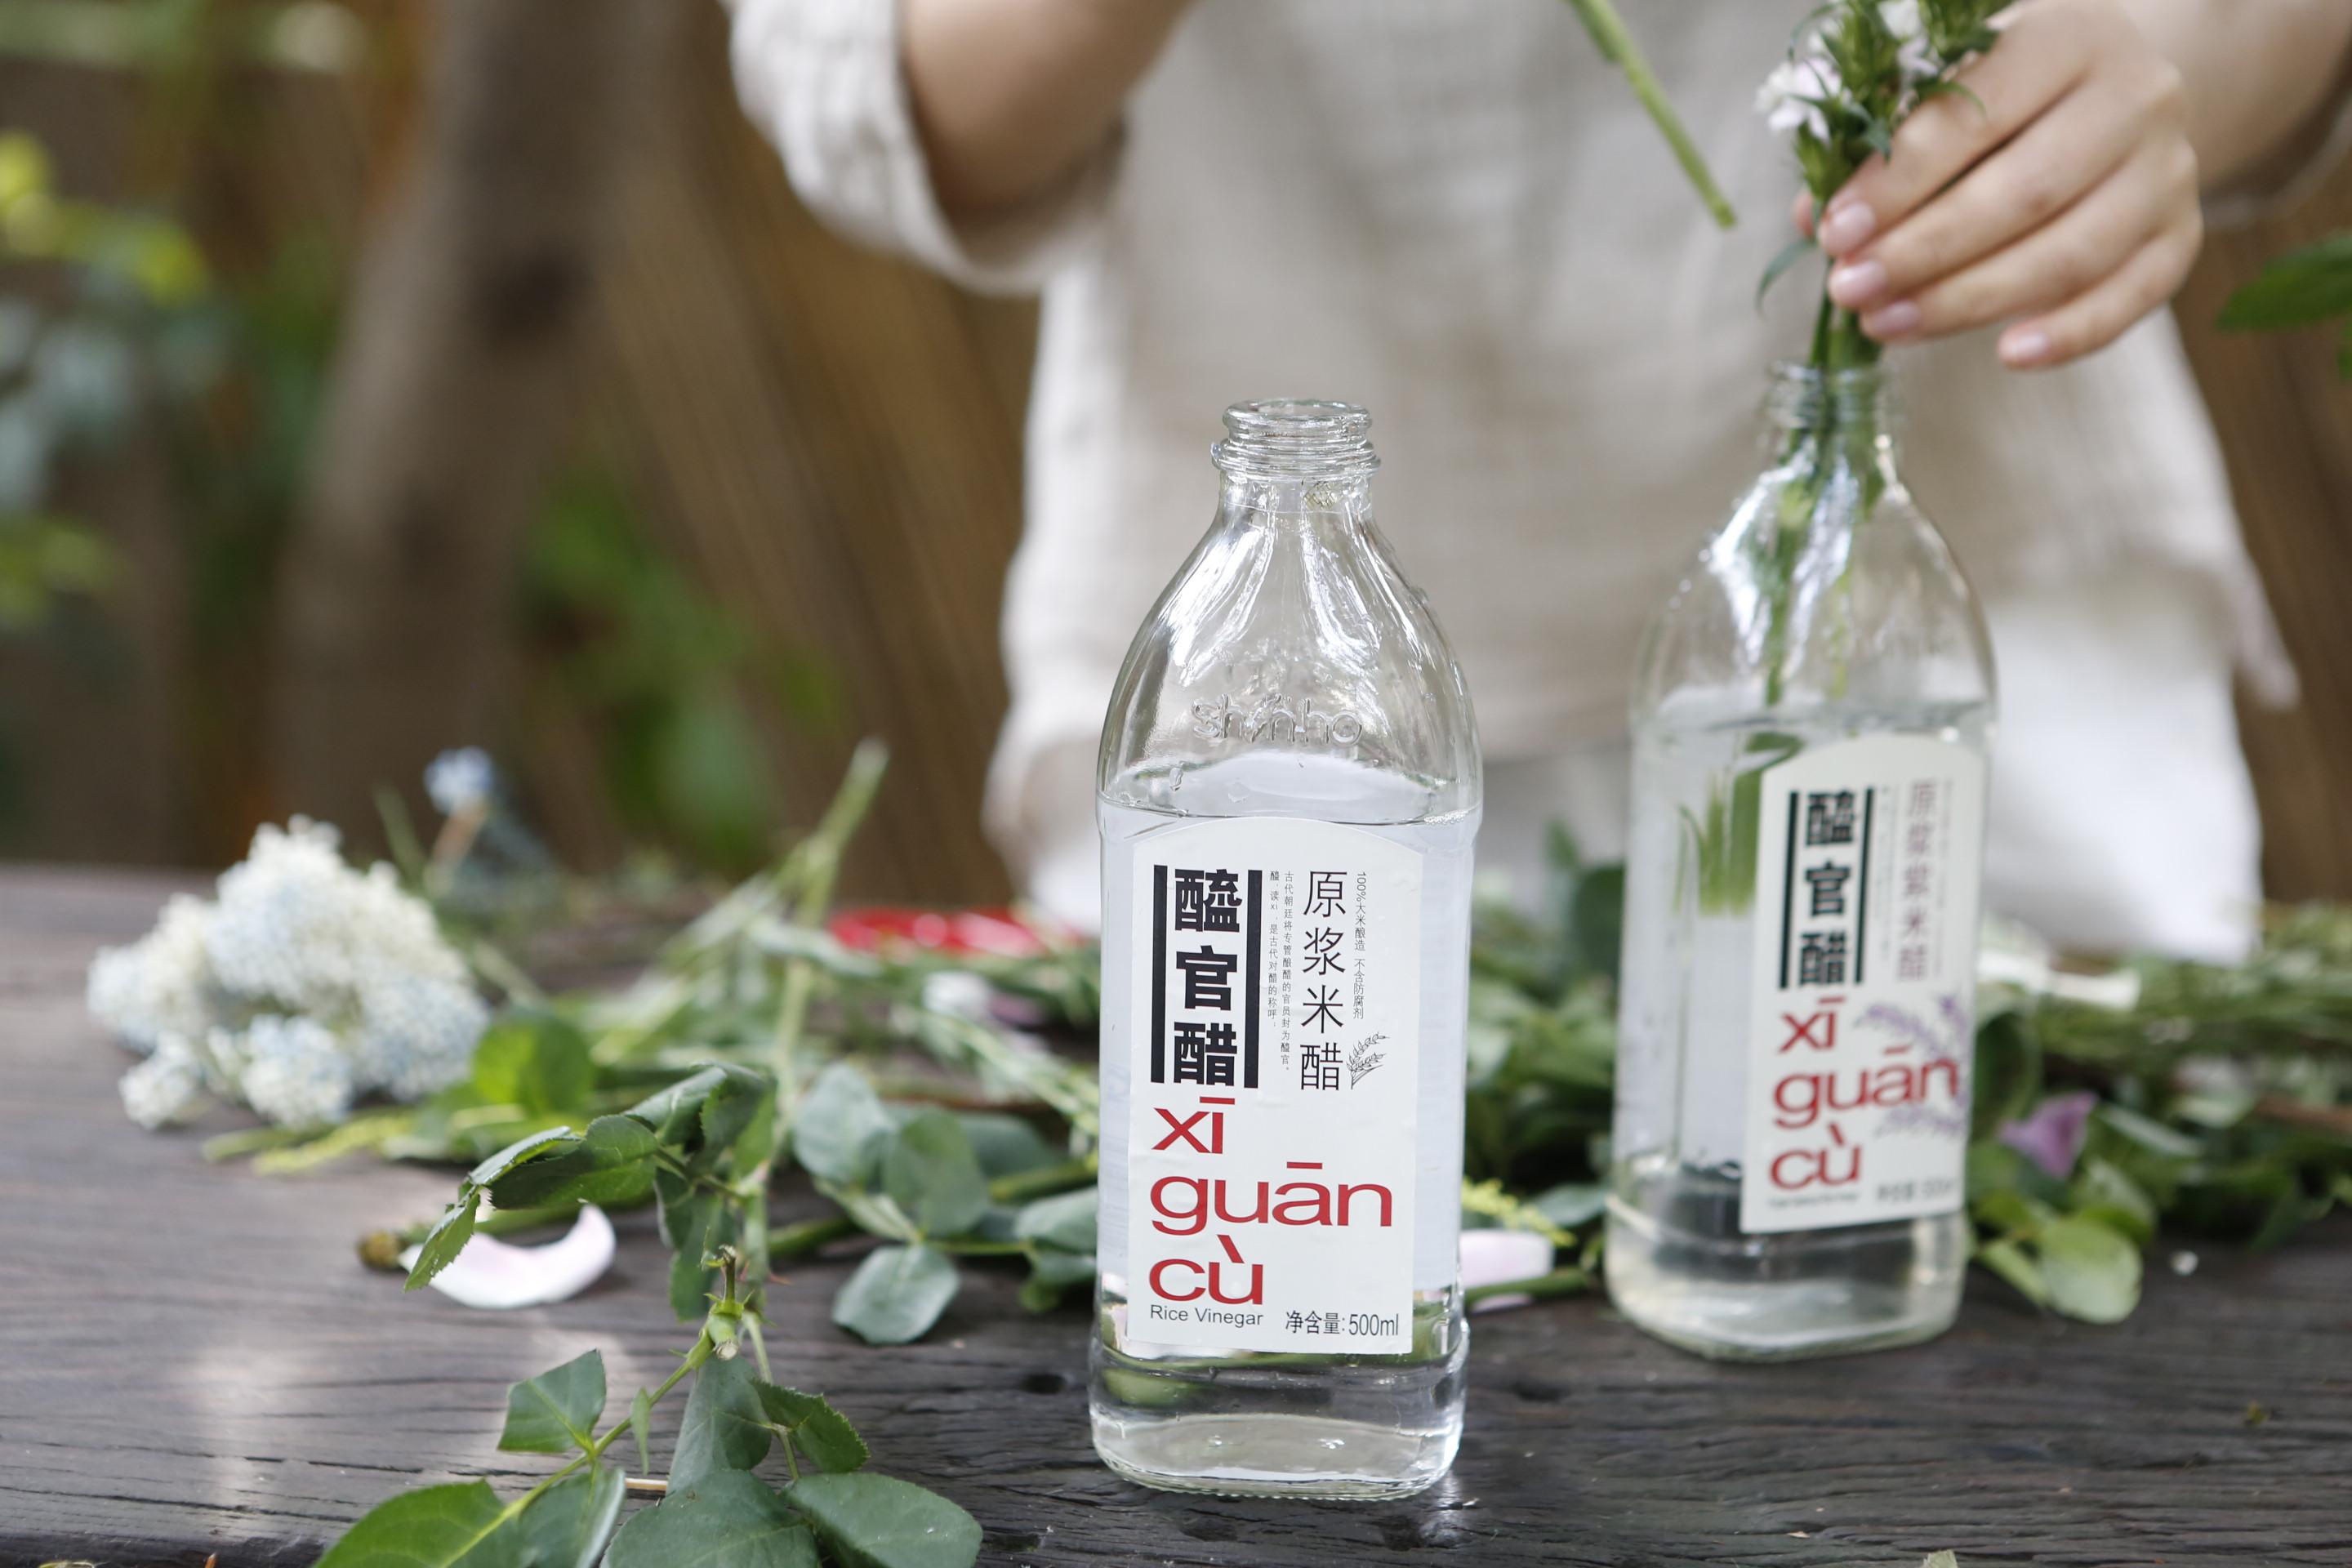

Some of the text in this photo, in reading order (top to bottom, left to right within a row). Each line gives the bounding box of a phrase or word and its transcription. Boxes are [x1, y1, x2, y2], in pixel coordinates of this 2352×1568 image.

[1173, 868, 1242, 1086] 醯官醋
[1300, 871, 1348, 1090] 原浆米醋
[1352, 959, 1365, 1019] 不含防腐剂
[1779, 996, 1847, 1054] xī
[1774, 1045, 1958, 1129] guān
[1152, 1096, 1236, 1154] xī
[1769, 1122, 1862, 1191] cù
[1150, 1161, 1392, 1236] guān
[1149, 1234, 1263, 1305] cù
[1150, 1304, 1263, 1330] Rice Vinegar
